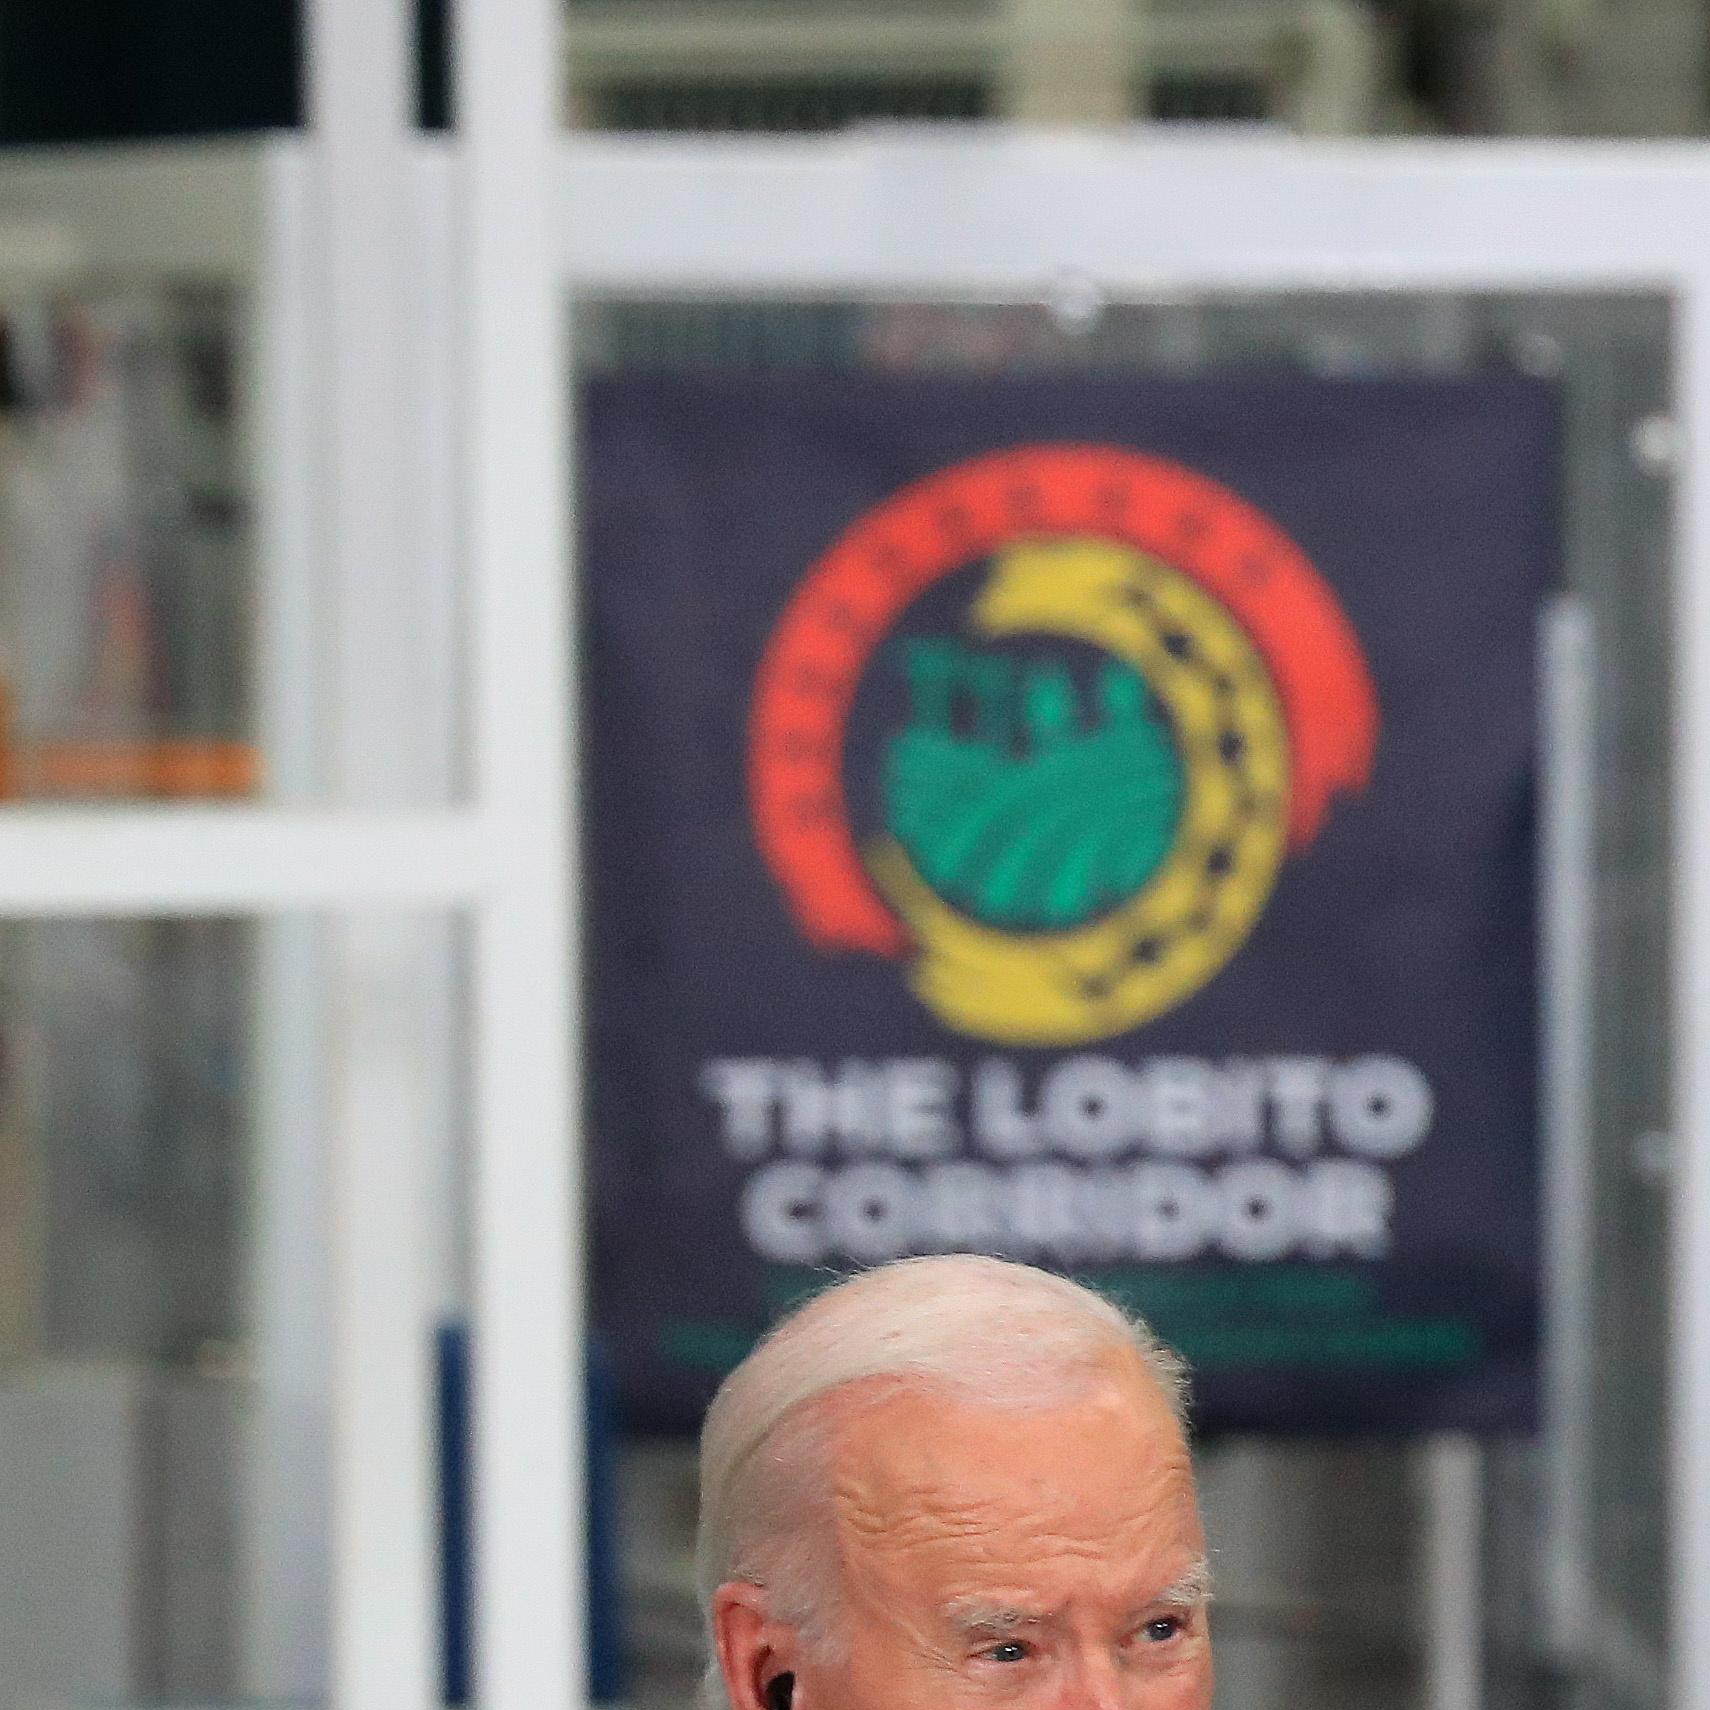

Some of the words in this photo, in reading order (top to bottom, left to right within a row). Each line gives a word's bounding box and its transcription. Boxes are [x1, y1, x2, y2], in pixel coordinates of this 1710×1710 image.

[702, 1056, 958, 1160] THE
[972, 1054, 1436, 1160] LOBITO
[740, 1157, 1395, 1263] CORRIDOR
